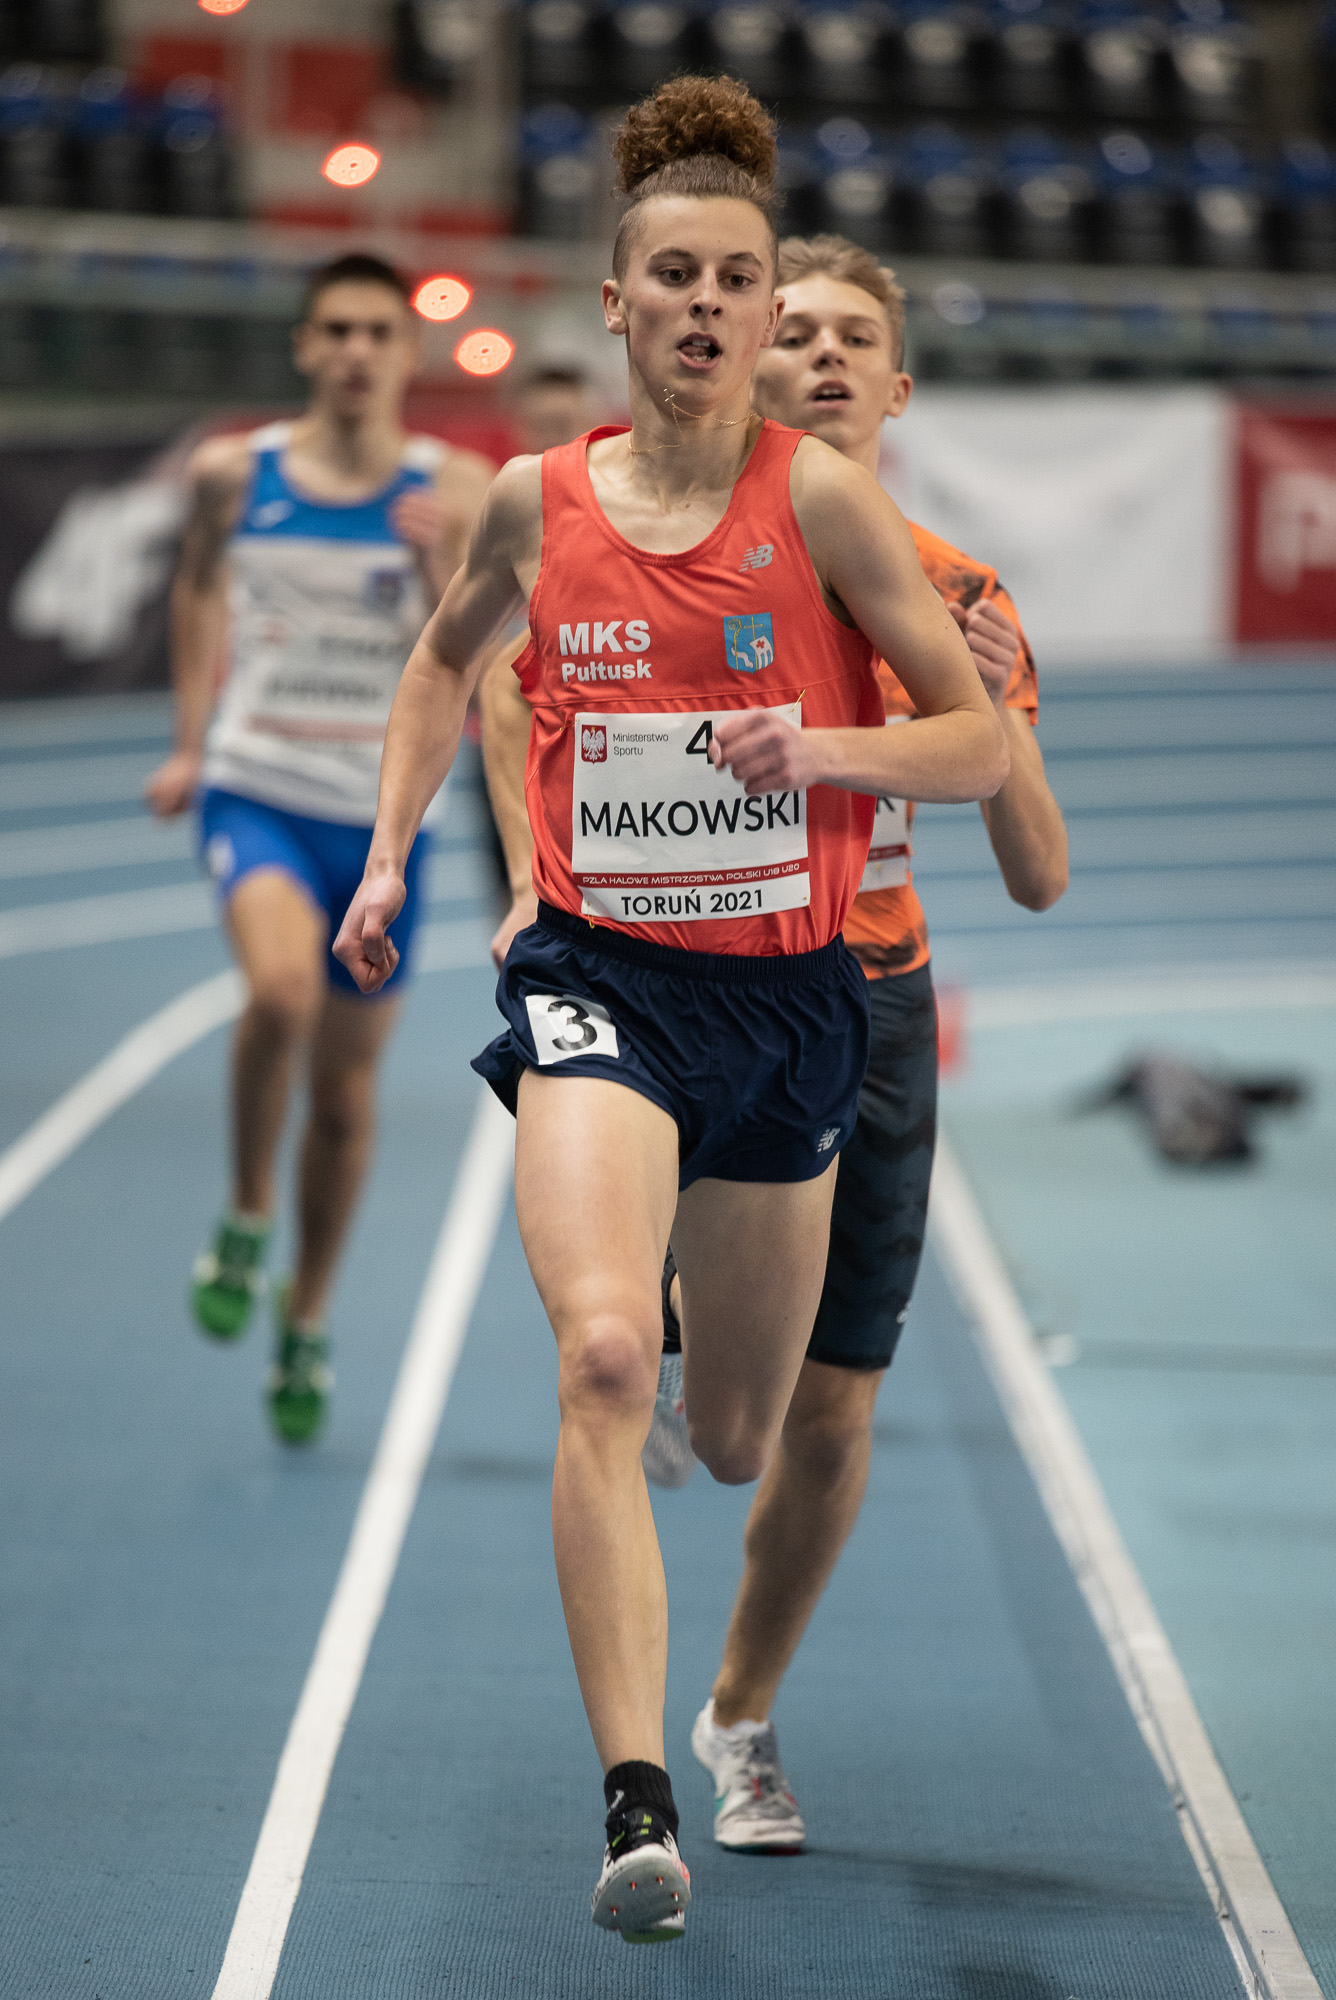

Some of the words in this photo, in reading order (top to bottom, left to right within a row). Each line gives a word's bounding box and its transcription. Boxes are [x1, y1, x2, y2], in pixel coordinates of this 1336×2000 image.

[558, 619, 651, 656] MKS
[561, 658, 653, 683] Pułtusk
[613, 733, 669, 743] Ministerstwo
[613, 746, 644, 757] Sportu
[580, 789, 800, 838] MAKOWSKI
[582, 876, 608, 885] PZLA
[609, 876, 649, 885] HALOWE
[651, 873, 725, 884] MISTRZOSTWA
[726, 869, 762, 881] POLSKI
[763, 867, 780, 877] U18
[782, 863, 800, 873] U20
[621, 888, 702, 916] TORUŃ
[710, 889, 763, 913] 2021
[547, 1000, 598, 1052] 3
